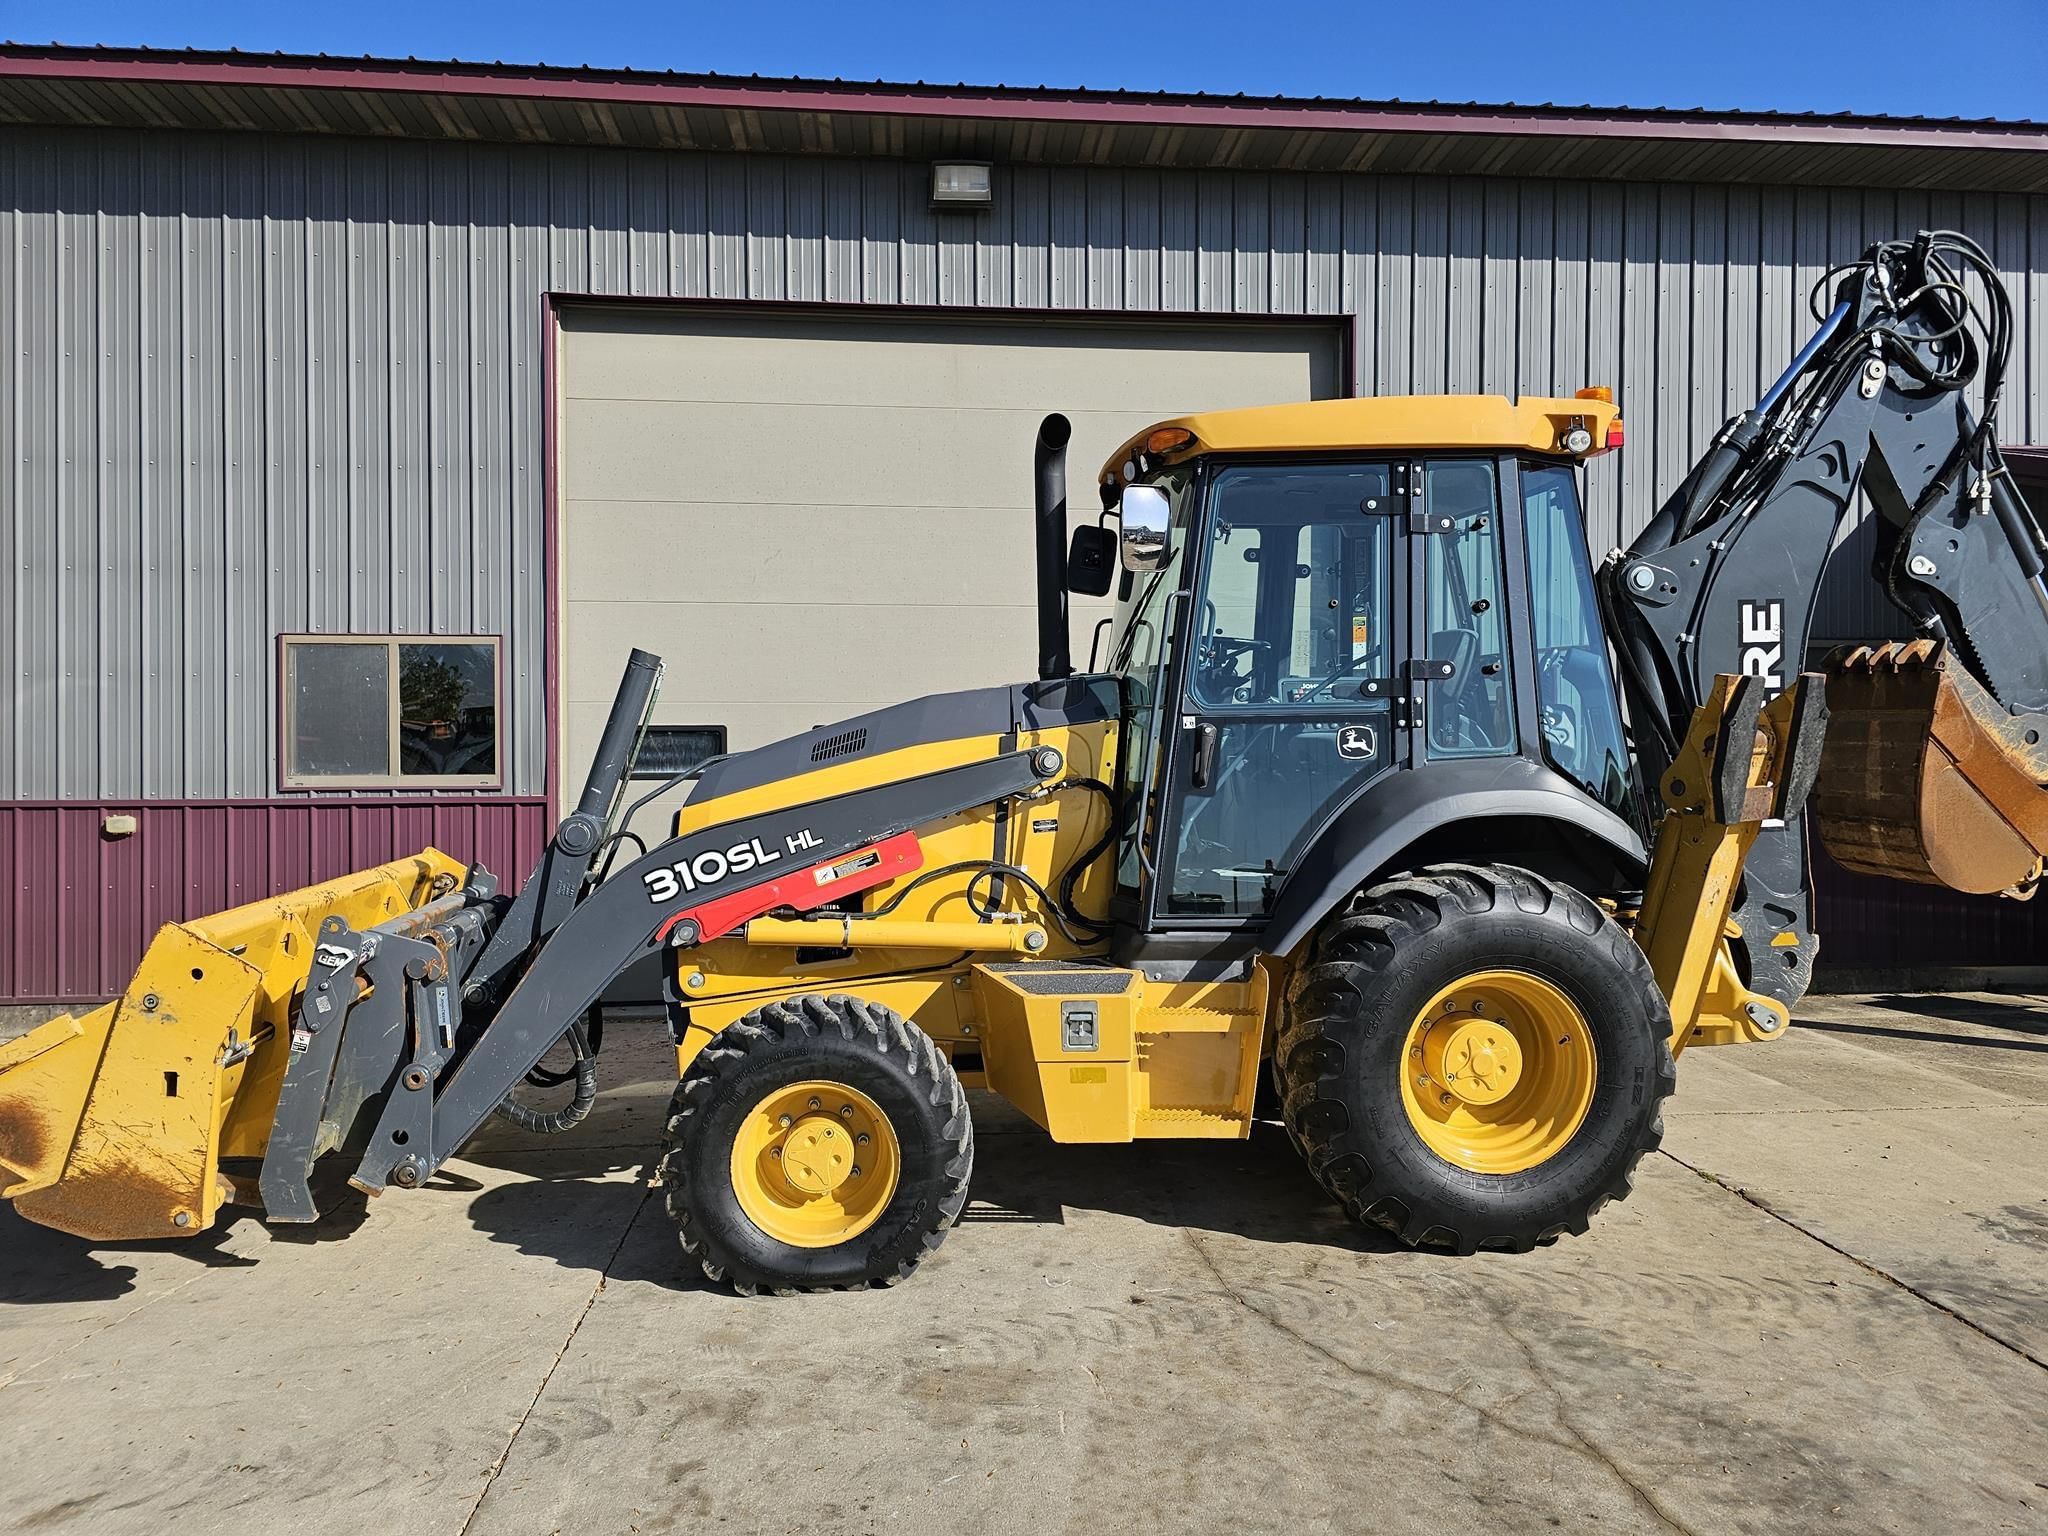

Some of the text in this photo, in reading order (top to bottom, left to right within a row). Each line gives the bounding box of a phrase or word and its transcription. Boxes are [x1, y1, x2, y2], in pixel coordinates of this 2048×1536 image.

[643, 829, 824, 903] 310SL HL
[317, 954, 345, 968] GEM
[1365, 940, 1447, 1038] GALAXY
